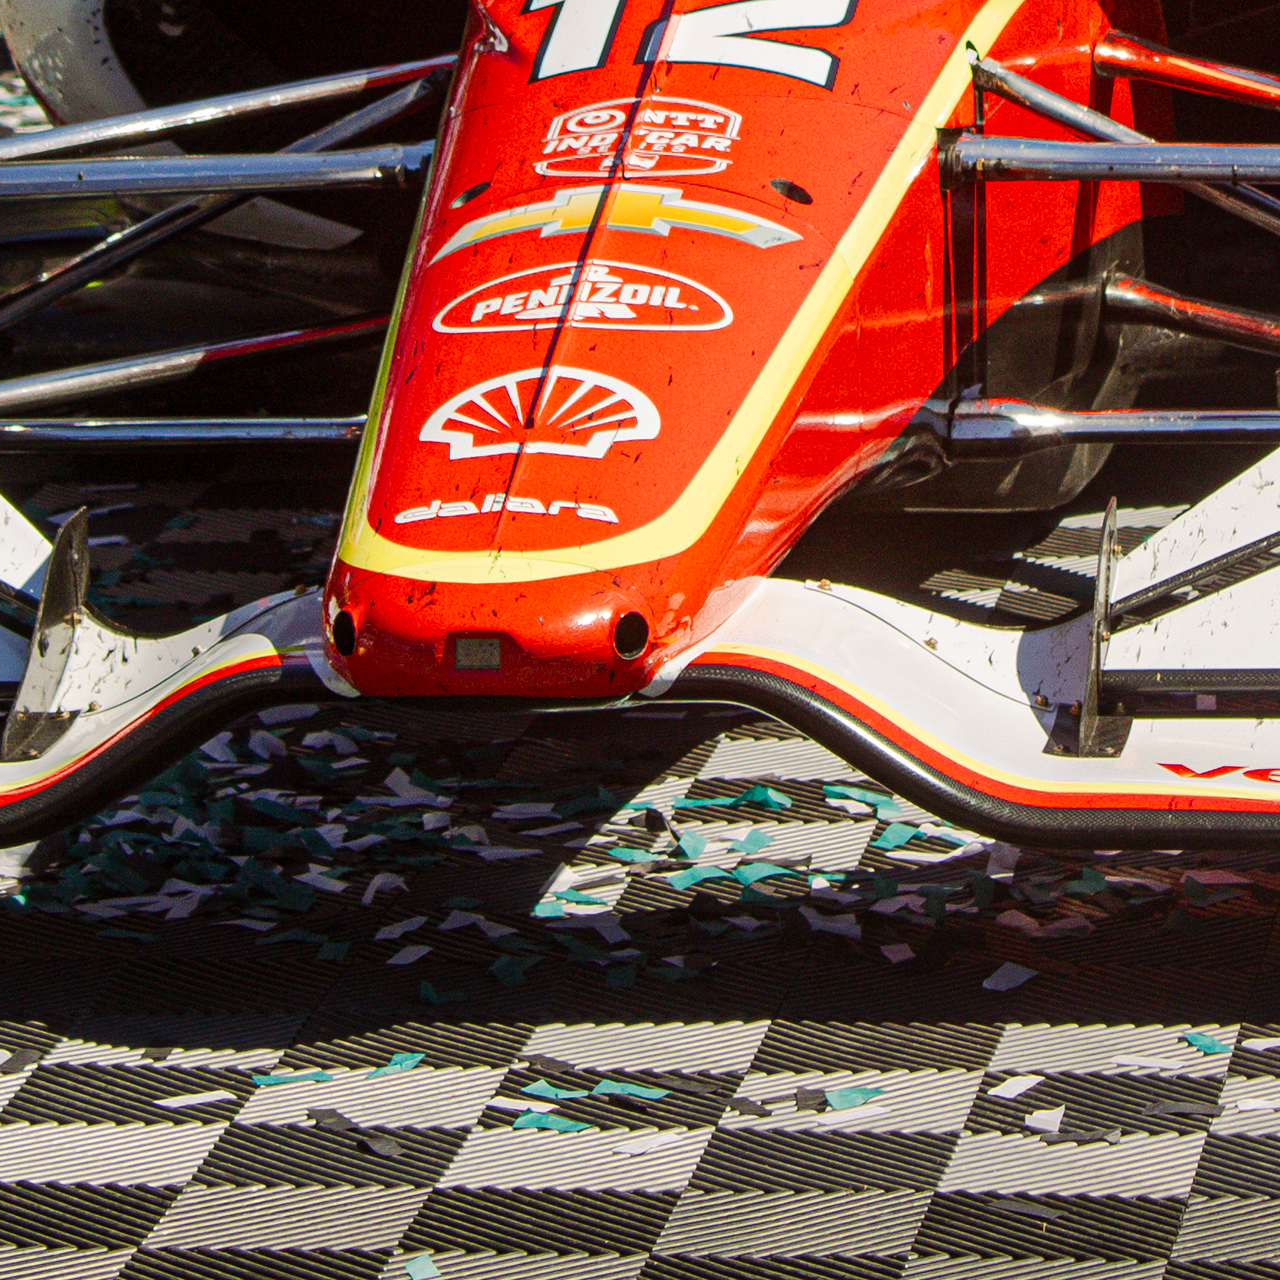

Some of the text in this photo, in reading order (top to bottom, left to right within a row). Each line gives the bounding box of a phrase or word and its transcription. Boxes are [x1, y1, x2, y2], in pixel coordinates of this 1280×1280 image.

[643, 108, 725, 129] NTT
[542, 130, 732, 155] INDCAR
[576, 142, 687, 156] SEIES
[471, 282, 687, 323] PENNZOIL
[394, 492, 620, 524] dallara
